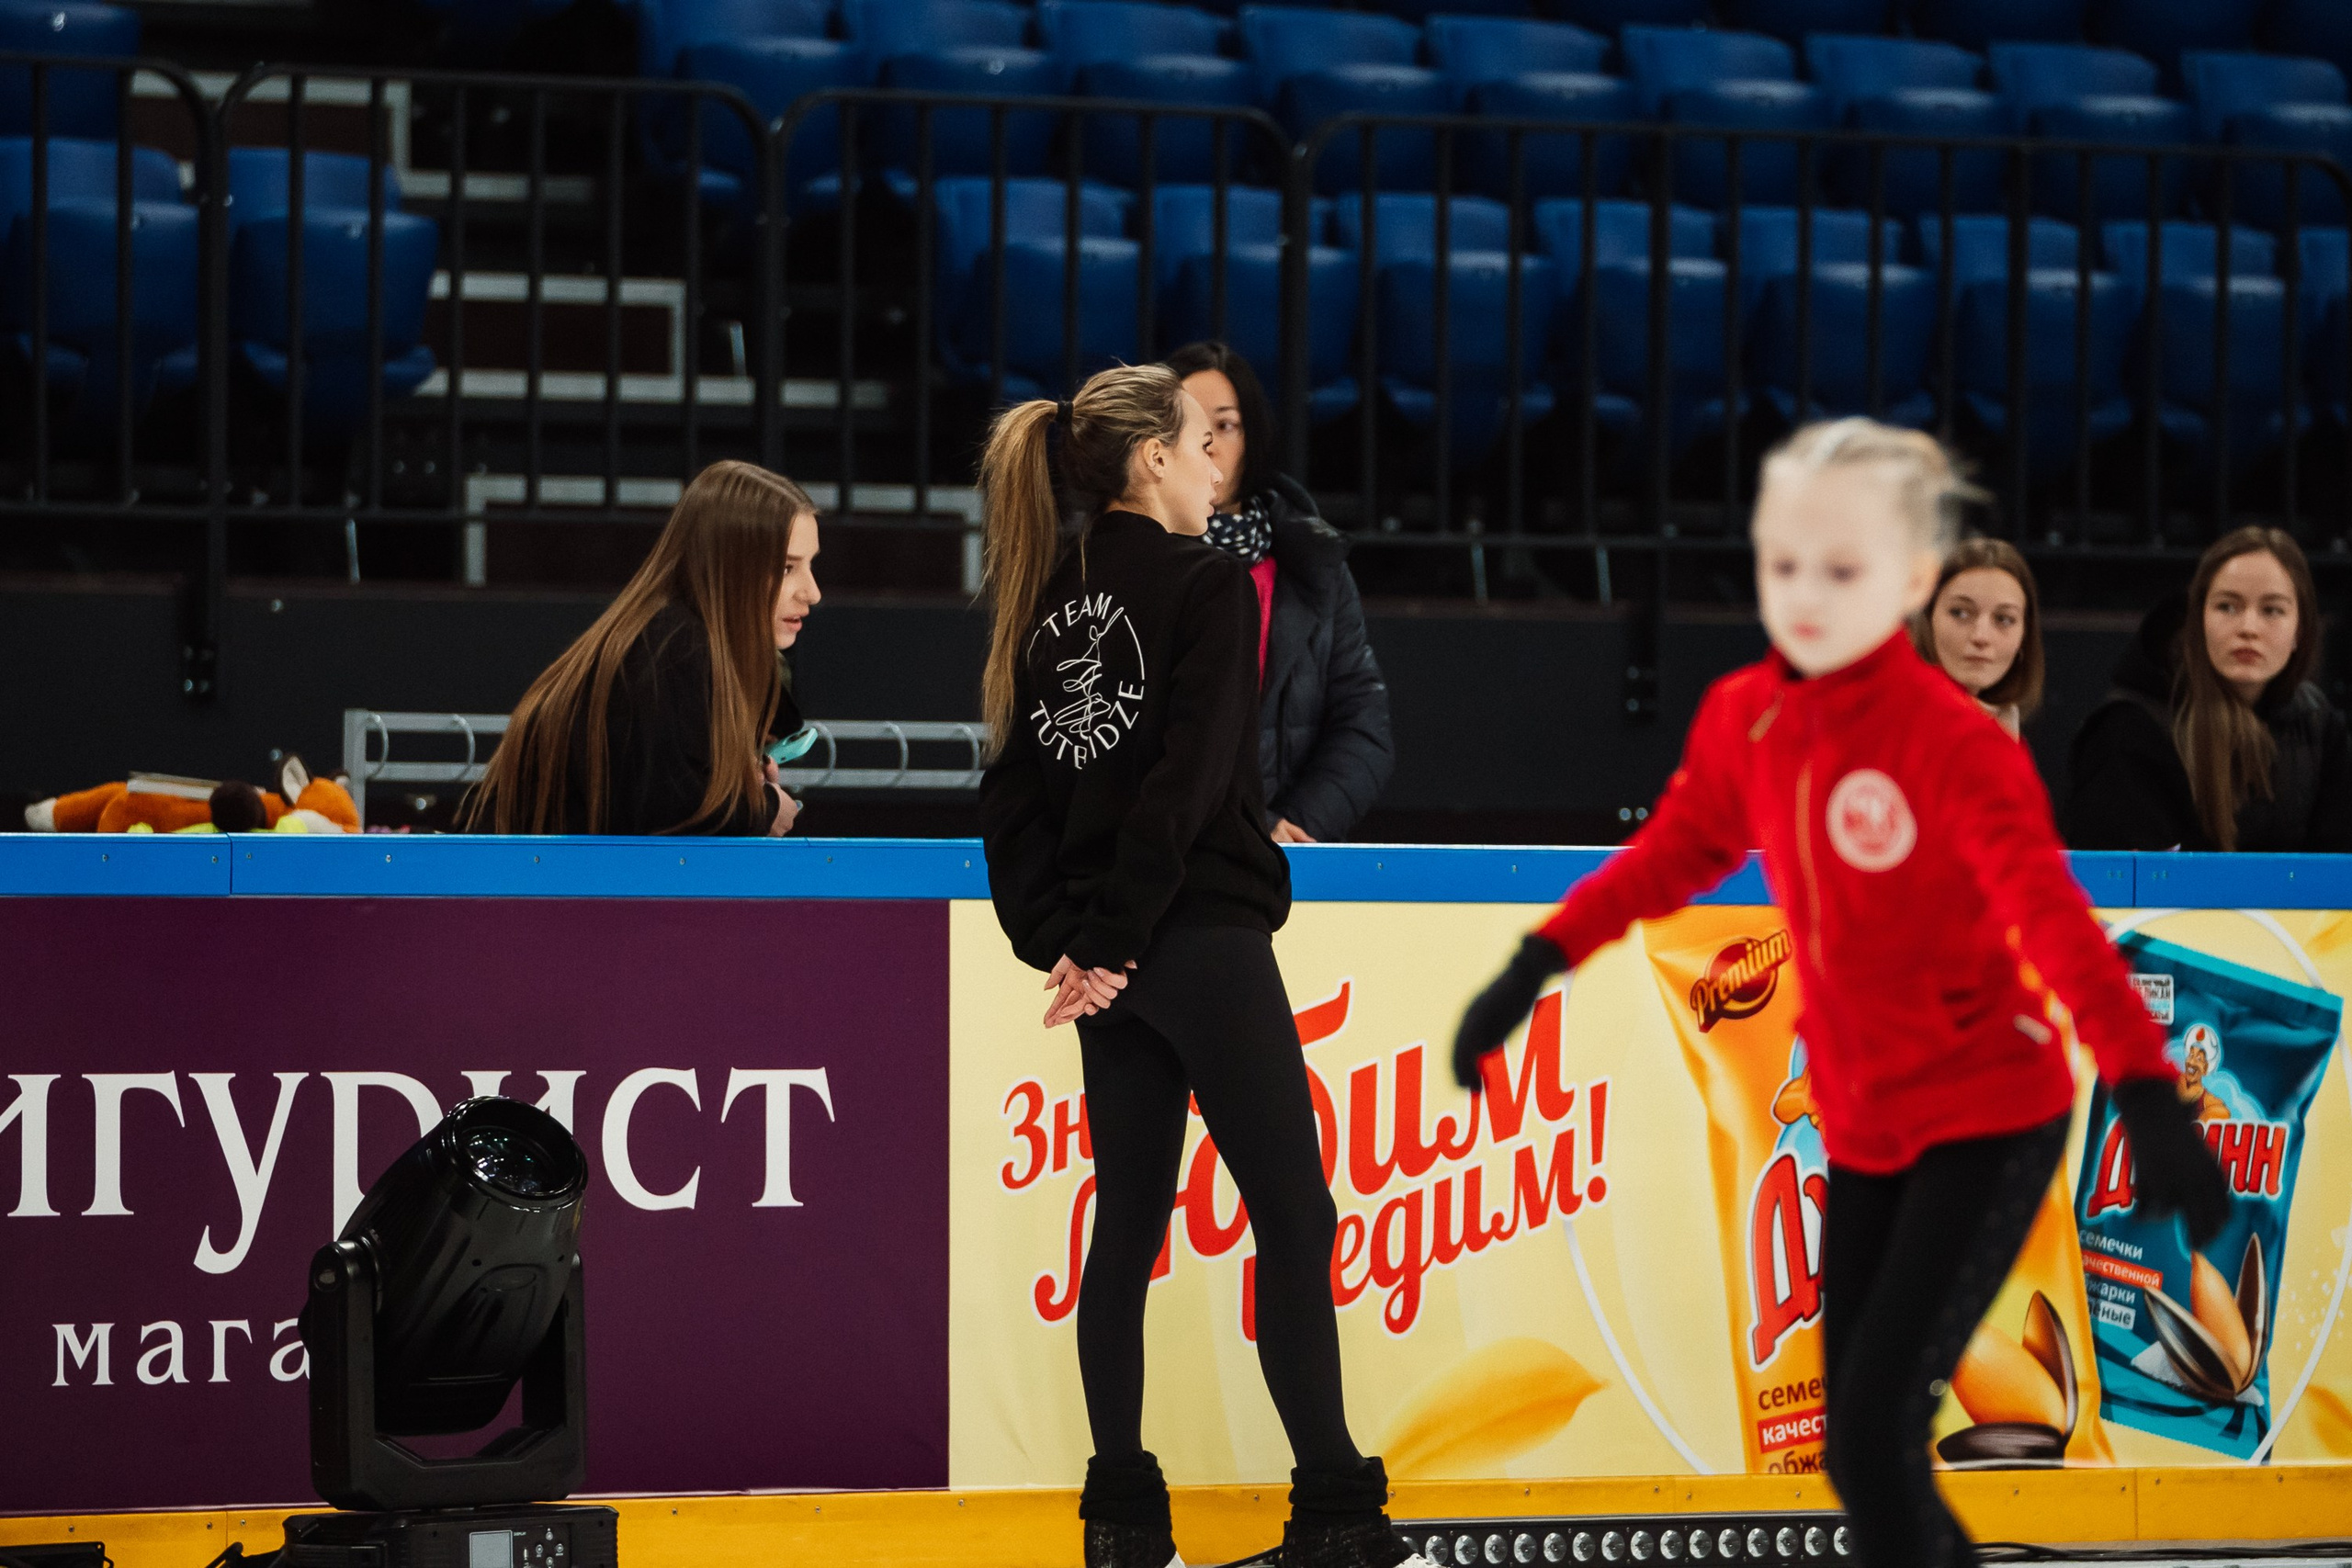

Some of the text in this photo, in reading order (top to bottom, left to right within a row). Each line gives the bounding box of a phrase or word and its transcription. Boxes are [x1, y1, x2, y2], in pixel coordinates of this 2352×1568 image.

[1042, 592, 1113, 637] TEAM
[1691, 930, 1792, 1027] Premium
[2079, 1230, 2143, 1261] семечки
[2082, 1254, 2161, 1288] ачественной
[2086, 1273, 2136, 1305] жарки
[1758, 1377, 1826, 1411] семе
